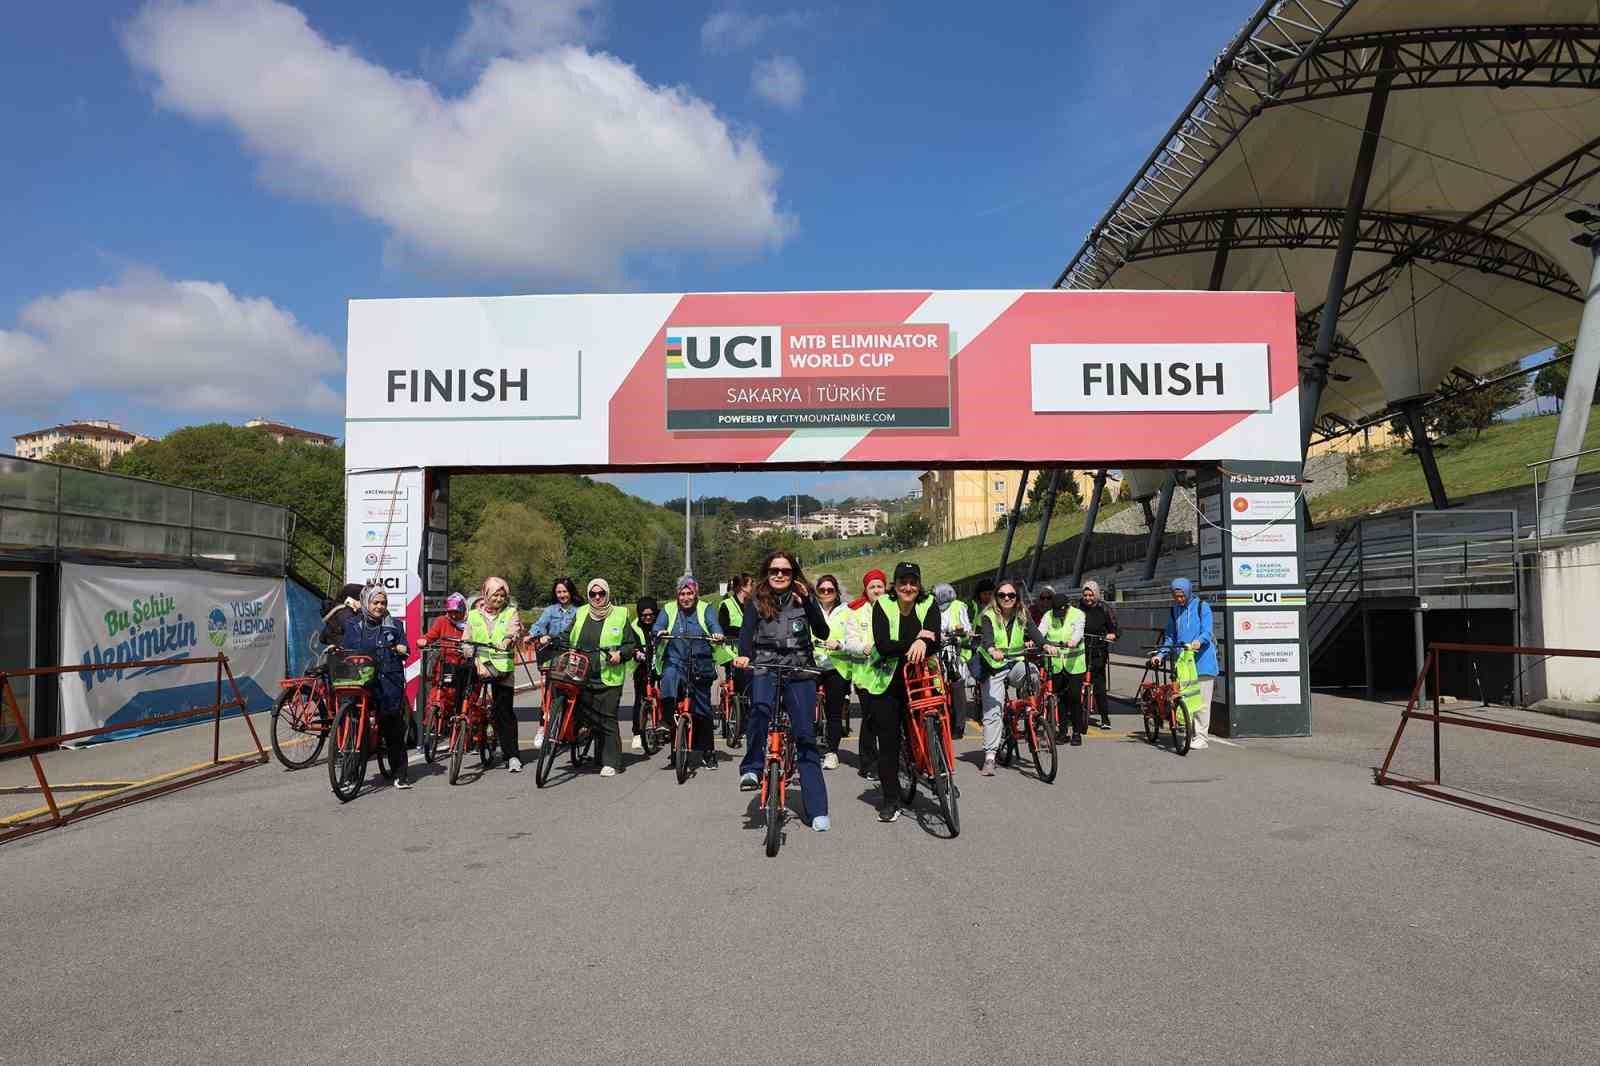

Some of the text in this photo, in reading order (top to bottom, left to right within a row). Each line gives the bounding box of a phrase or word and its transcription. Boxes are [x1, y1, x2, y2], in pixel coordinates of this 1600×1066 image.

[789, 334, 938, 349] MTB ELIMINATOR
[686, 335, 772, 369] UCI
[790, 353, 894, 368] WORLD CUP
[387, 368, 528, 402] FINISH
[1083, 362, 1224, 395] FINISH
[727, 382, 886, 403] SAKARYA TÜRKİYE
[718, 414, 895, 424] POWERED BY CITYMOUNTAINBIKE.COM
[1230, 474, 1297, 485] #Sakarya2025
[1253, 593, 1277, 602] UCI
[104, 592, 176, 637] Bu Şehir
[231, 602, 263, 618] YUSUF
[232, 617, 274, 635] ALEMDAR
[79, 613, 197, 691] Hepimizin
